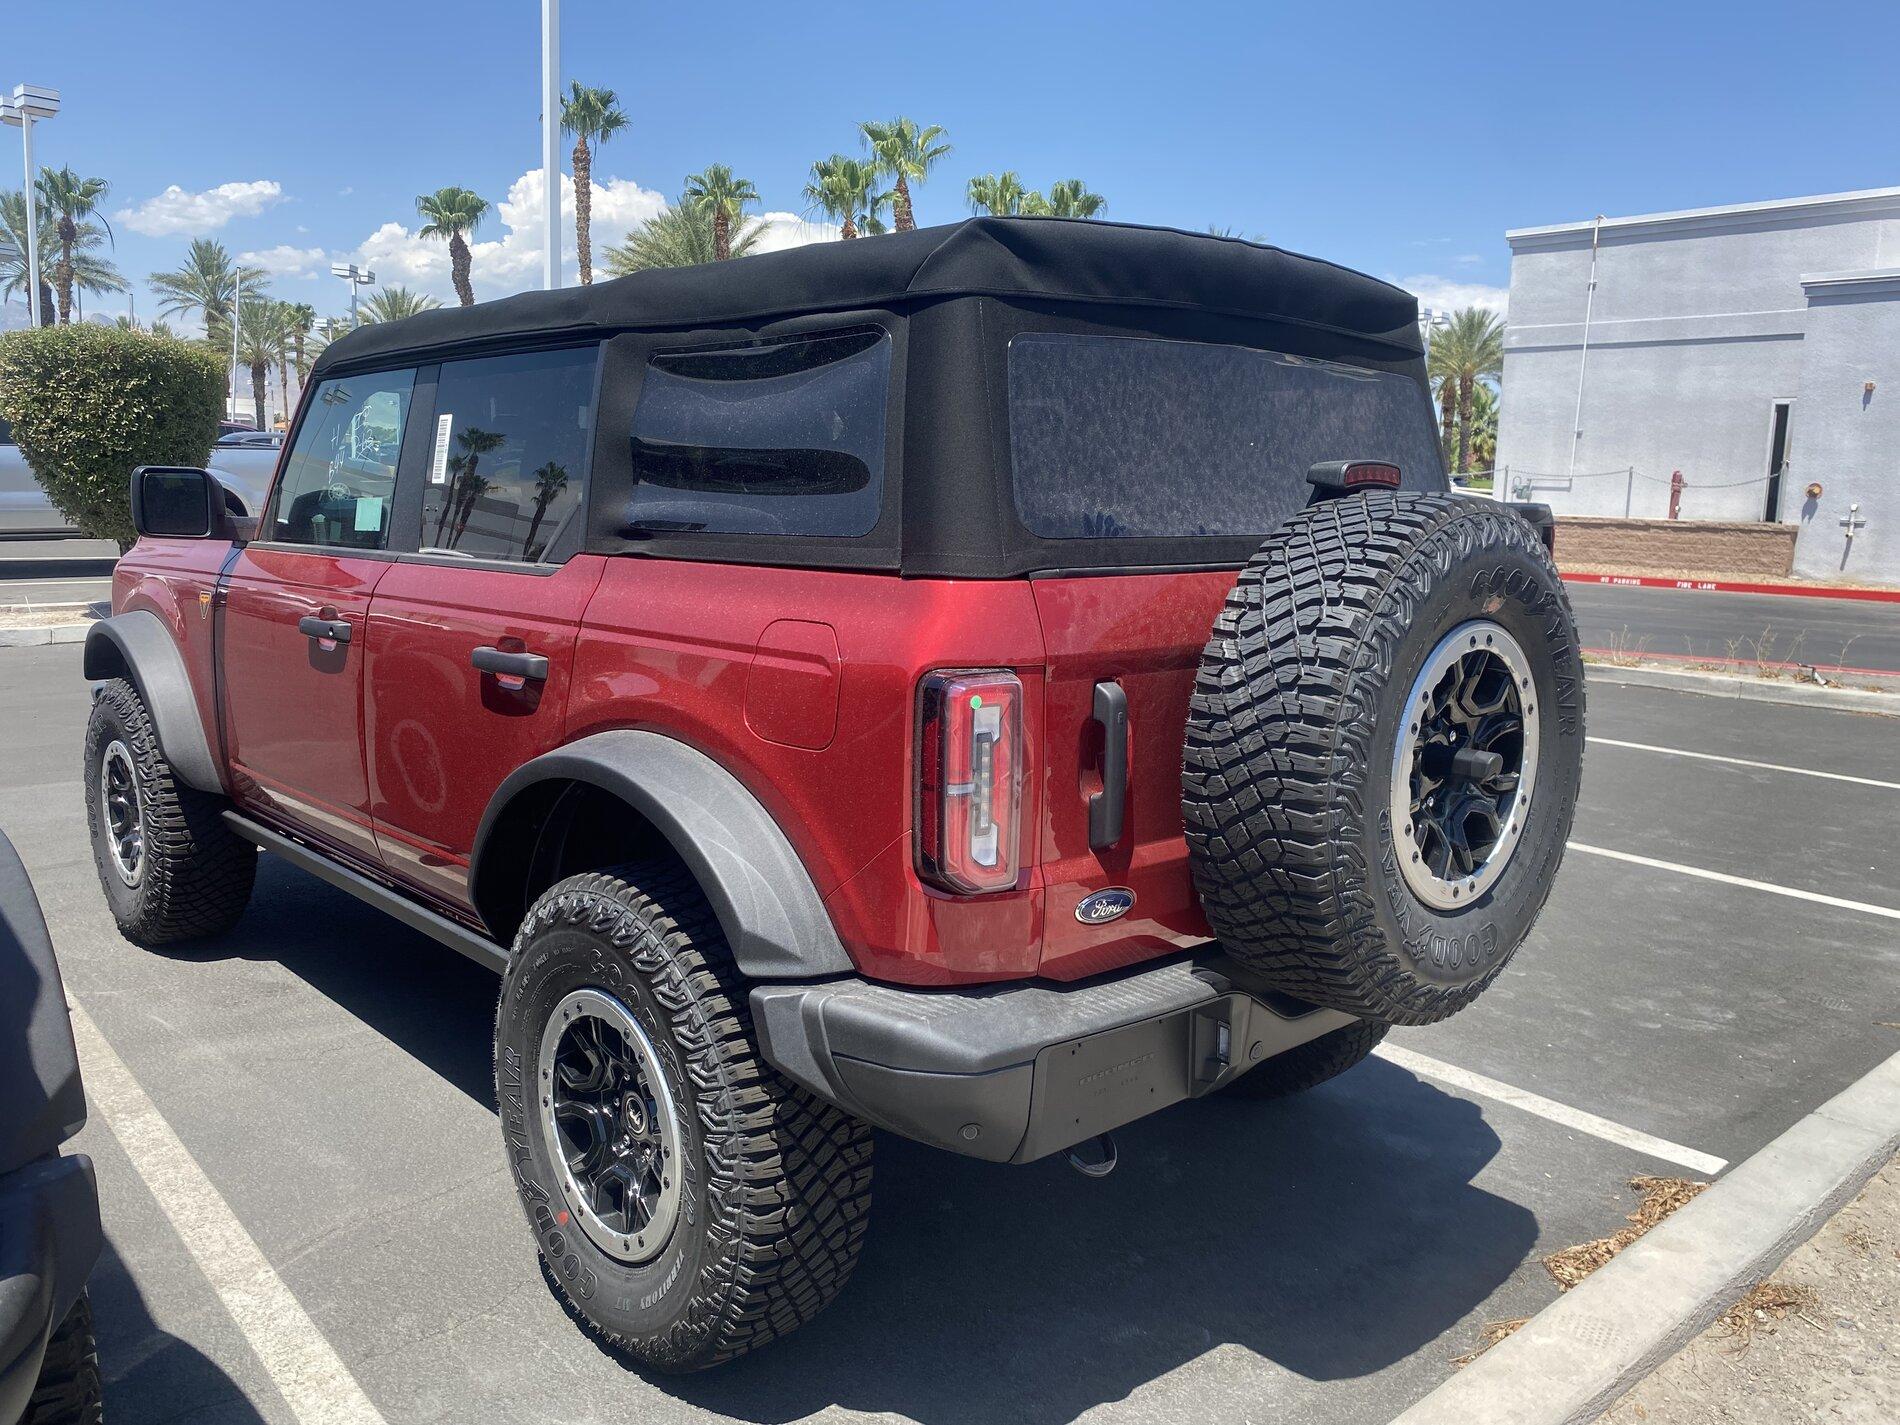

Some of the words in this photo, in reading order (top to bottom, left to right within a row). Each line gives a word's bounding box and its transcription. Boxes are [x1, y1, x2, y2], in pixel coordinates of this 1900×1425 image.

[1600, 576, 1610, 584] NO
[1613, 577, 1641, 586] PARKING
[1676, 581, 1693, 589] FIRE
[1698, 582, 1717, 590] LANE
[1470, 565, 1577, 738] GOODYEAR
[1091, 898, 1124, 918] Ford
[1378, 807, 1499, 971] GOODYEAR
[504, 1045, 598, 1300] GOODYEAR
[639, 1248, 685, 1311] TERRITORY
